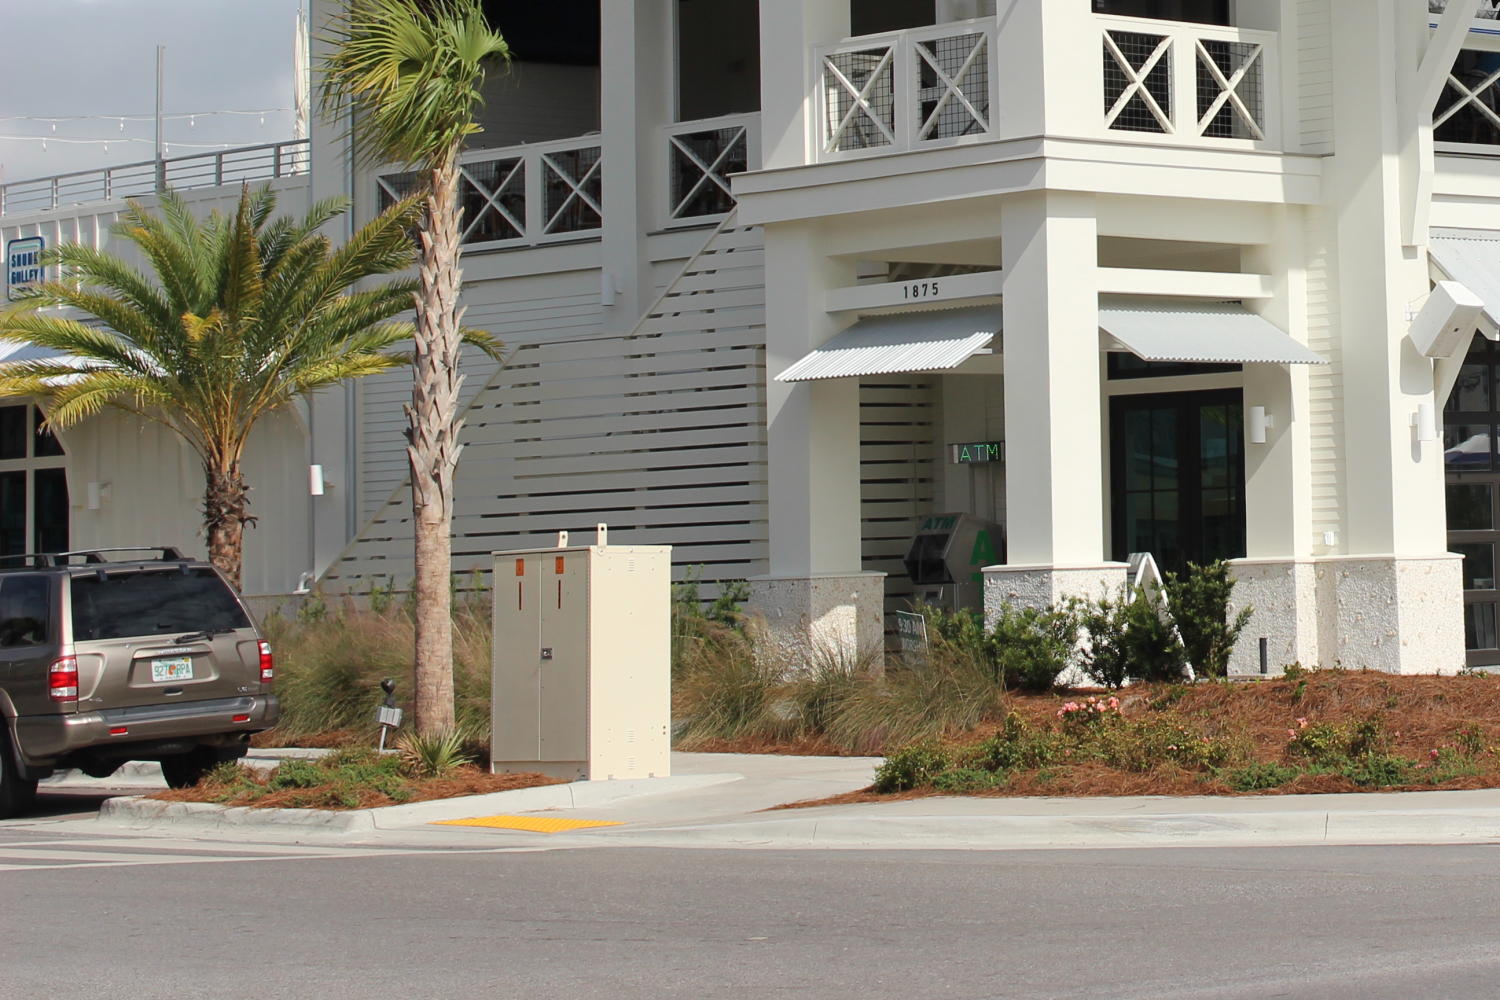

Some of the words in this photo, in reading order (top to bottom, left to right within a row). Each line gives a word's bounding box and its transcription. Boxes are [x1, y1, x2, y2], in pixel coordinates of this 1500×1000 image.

[11, 251, 38, 268] SHUNK
[903, 282, 939, 299] 1875
[960, 444, 999, 461] ATM
[921, 516, 957, 531] ATM
